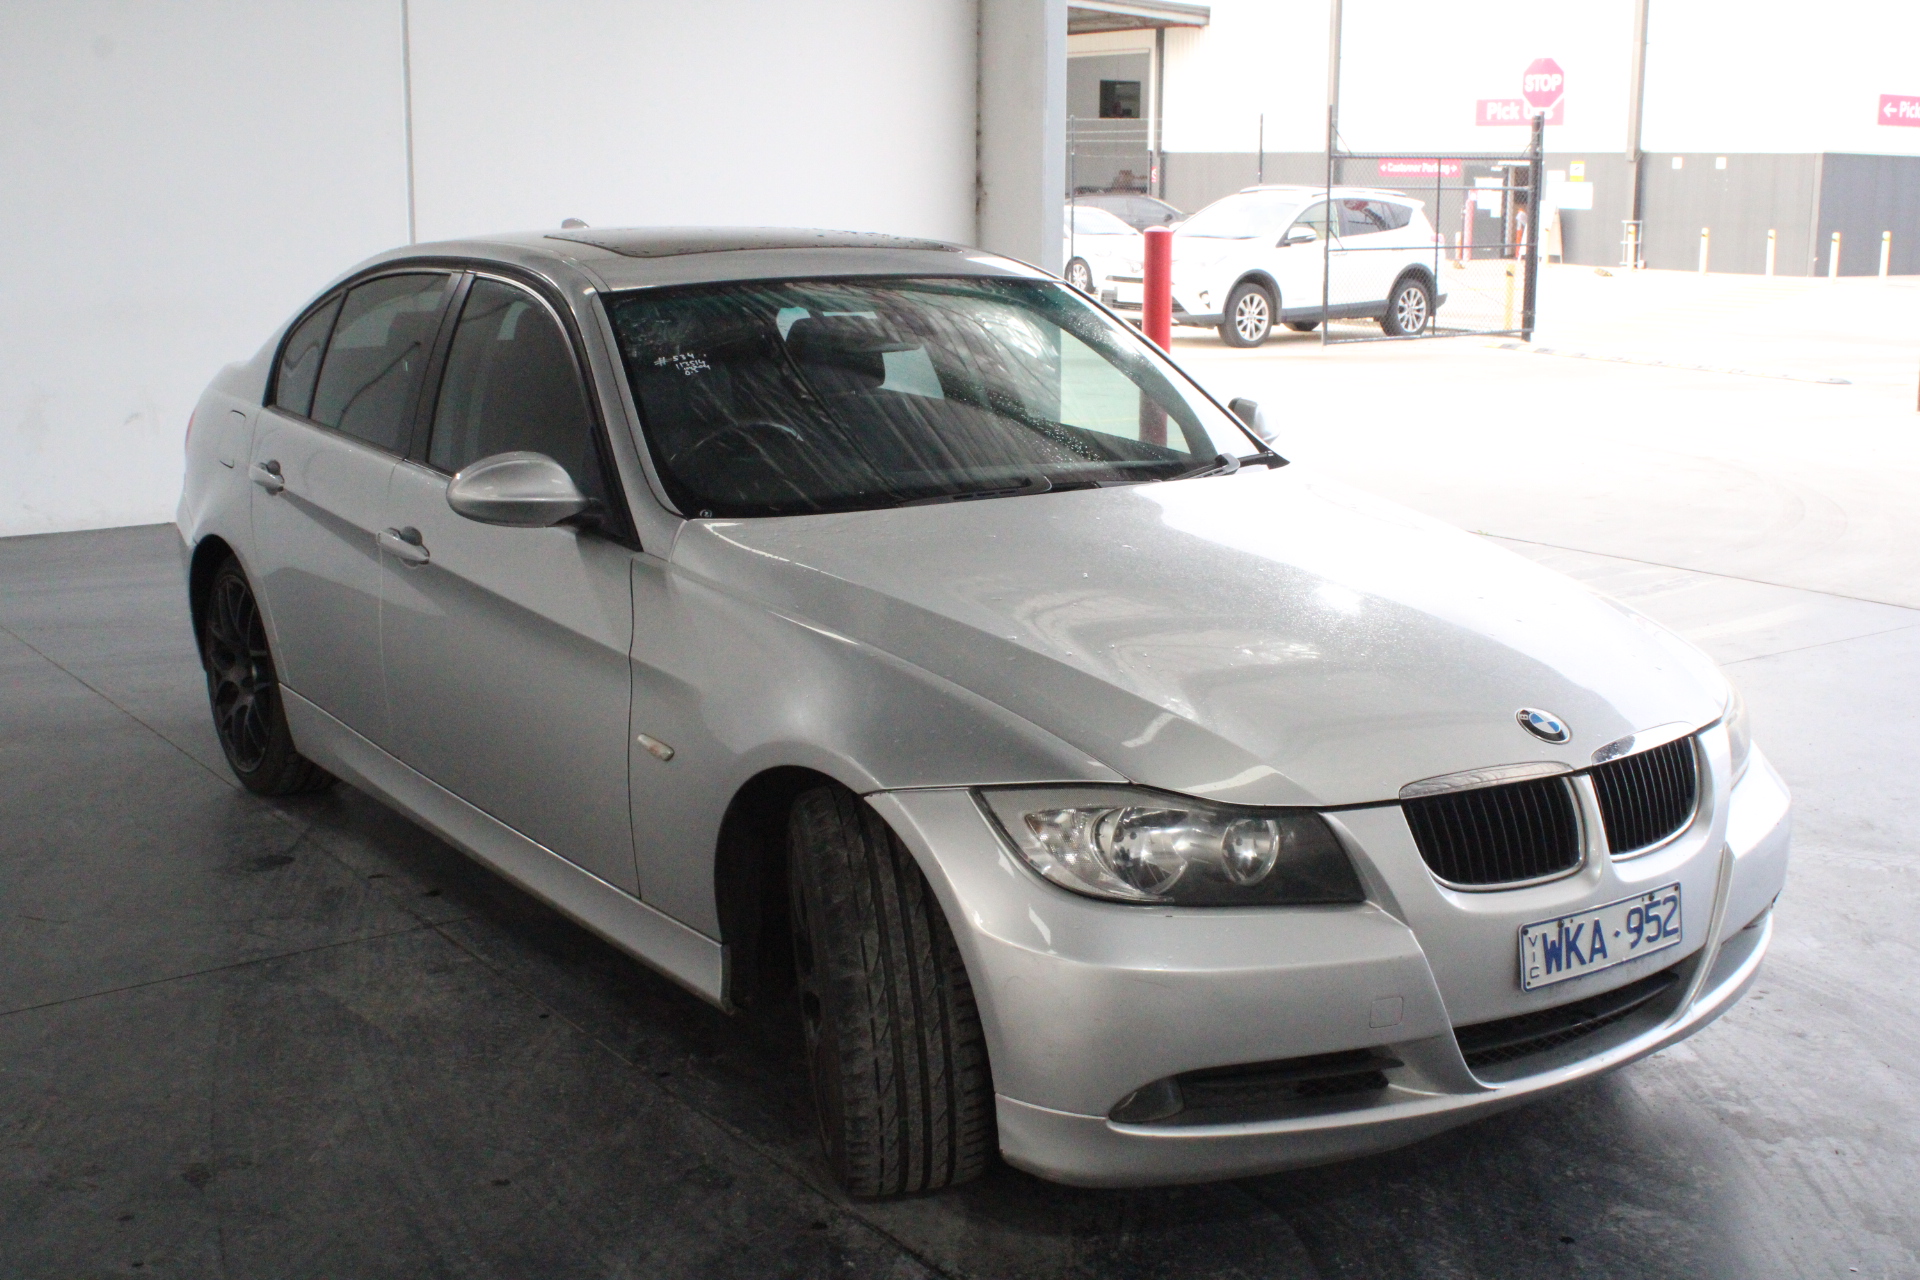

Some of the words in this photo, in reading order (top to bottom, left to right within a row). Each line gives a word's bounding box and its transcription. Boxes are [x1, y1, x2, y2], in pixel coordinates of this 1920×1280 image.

[1525, 74, 1562, 92] STOP
[1486, 102, 1520, 120] Pick
[1387, 162, 1422, 173] Customer
[1542, 919, 1608, 975] WKA
[1626, 894, 1679, 949] 952
[1528, 934, 1540, 979] VIC
